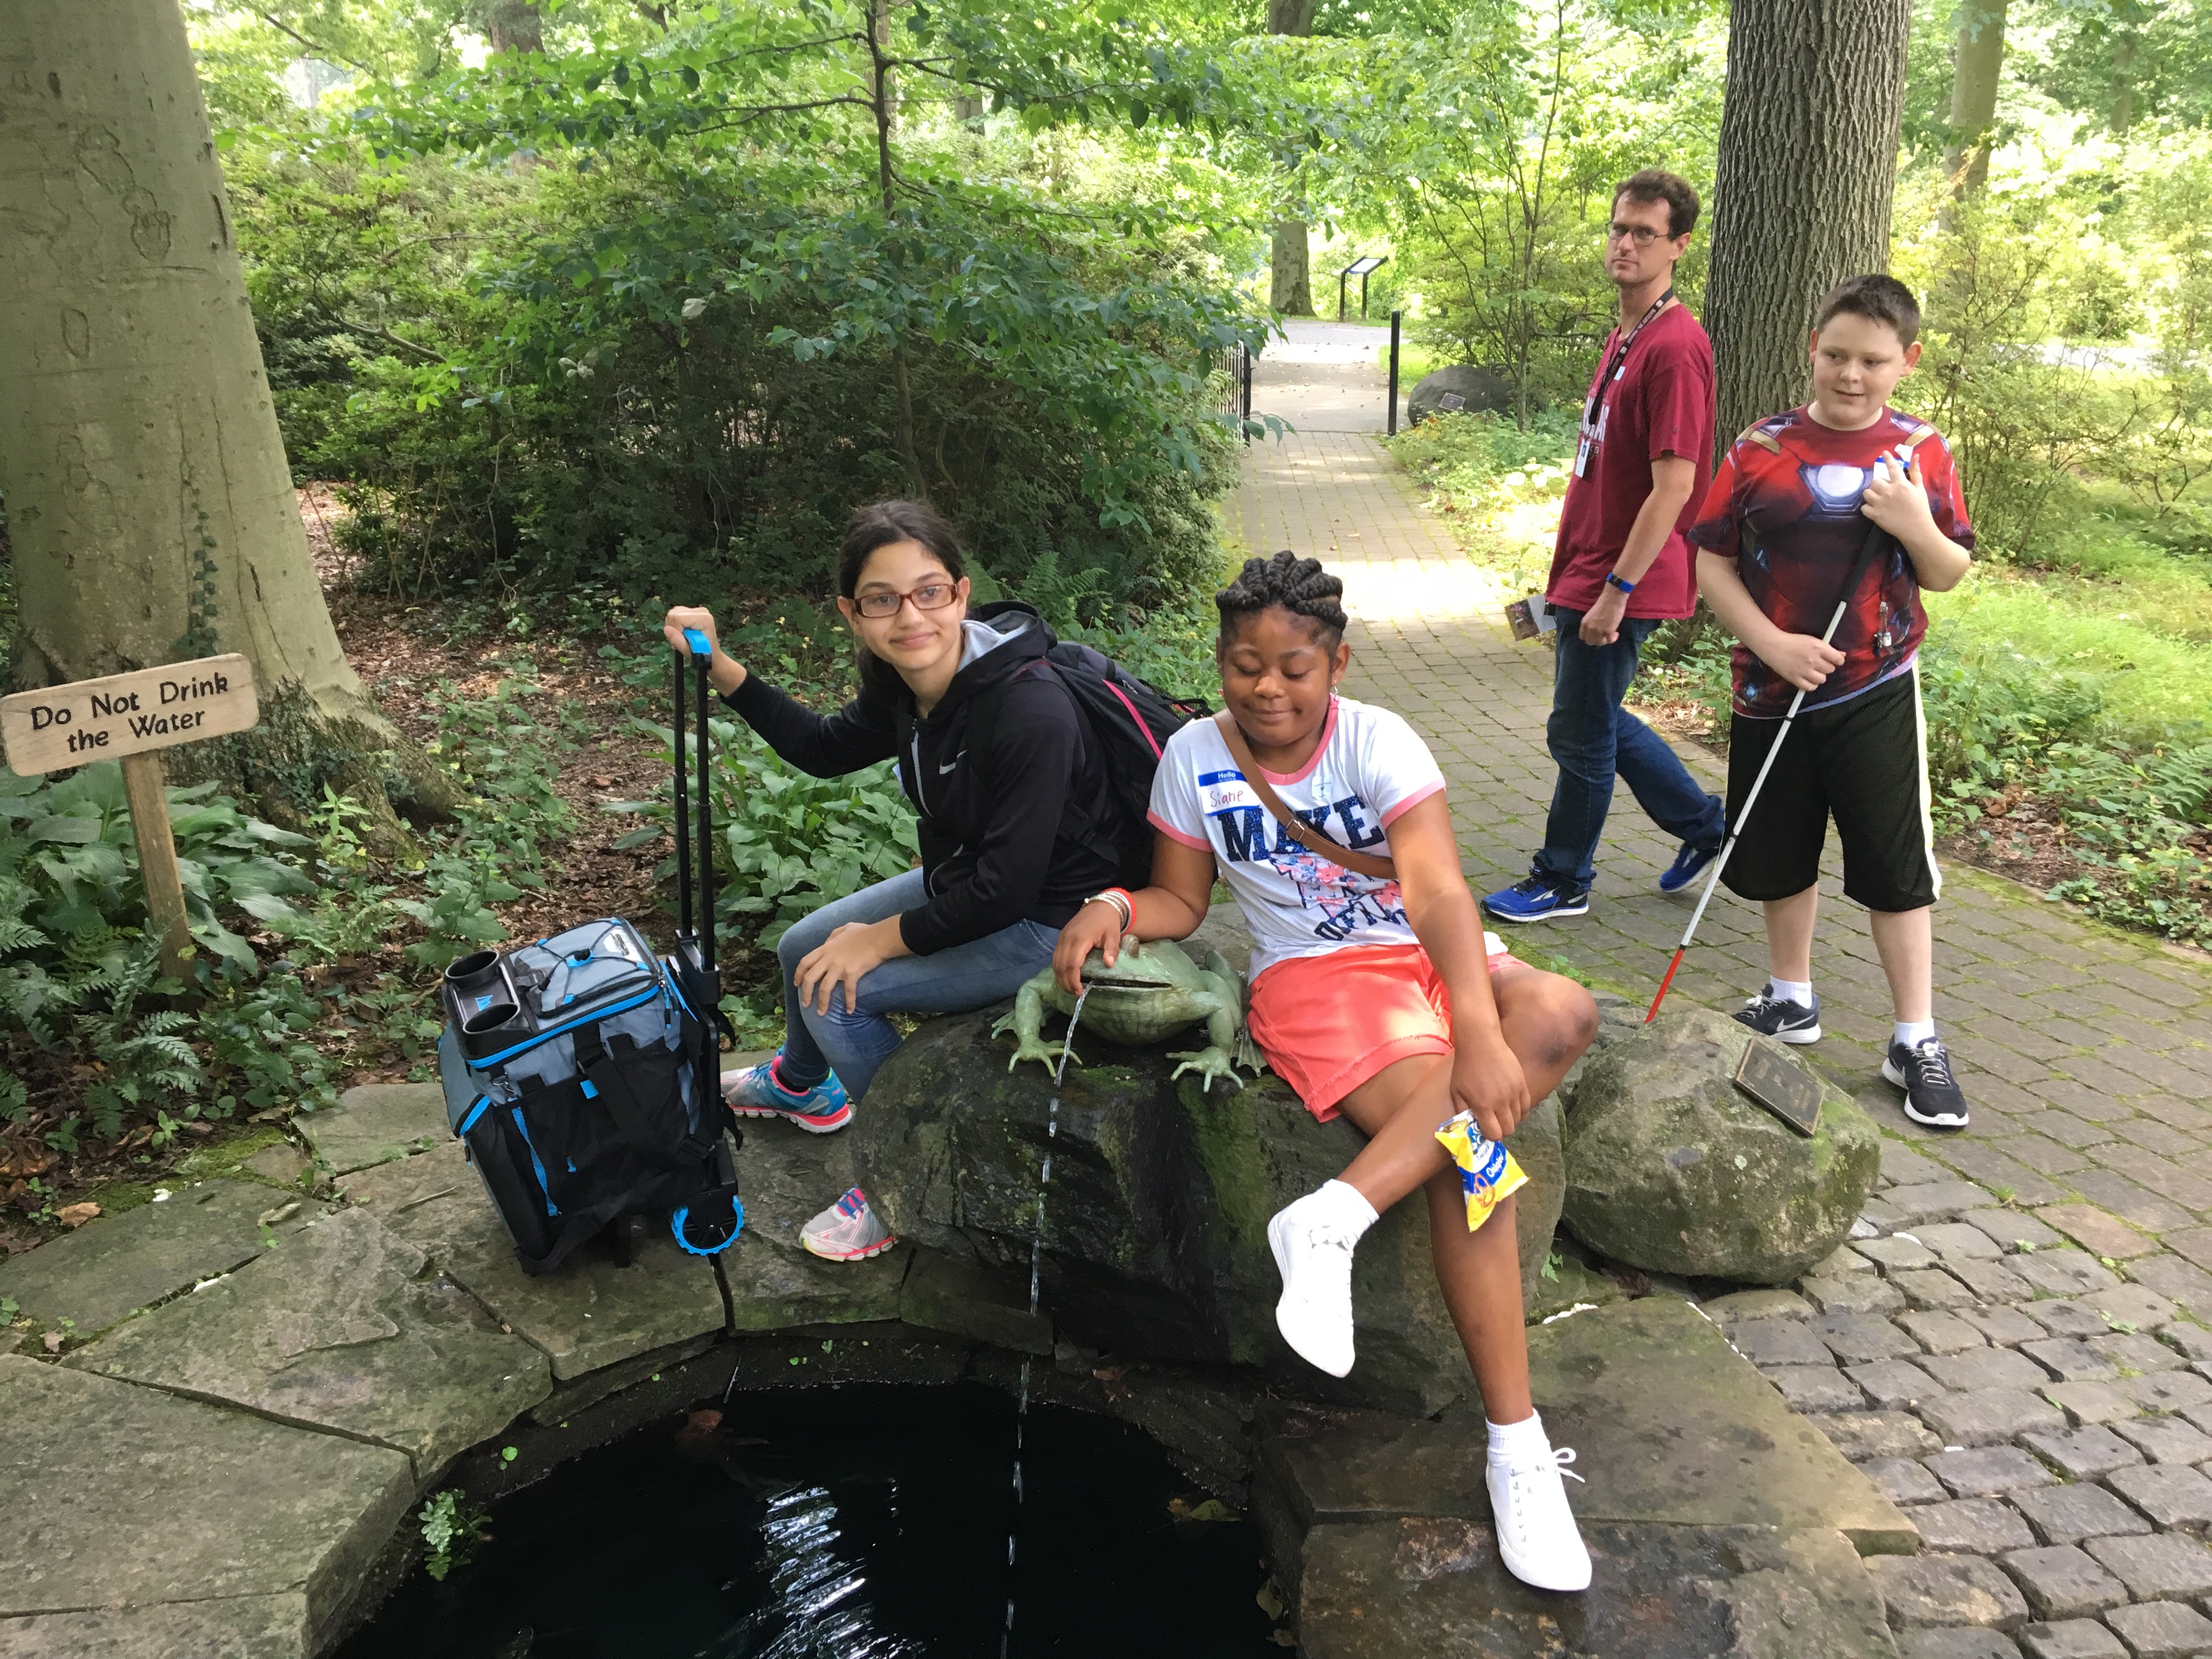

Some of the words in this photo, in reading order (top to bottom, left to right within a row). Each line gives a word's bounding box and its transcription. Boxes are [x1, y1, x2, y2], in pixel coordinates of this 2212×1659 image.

[31, 706, 71, 730] Do
[91, 692, 140, 718] Not
[159, 672, 228, 704] Drink
[66, 729, 109, 753] the
[128, 710, 206, 738] Water
[1216, 794, 1386, 862] MAKE
